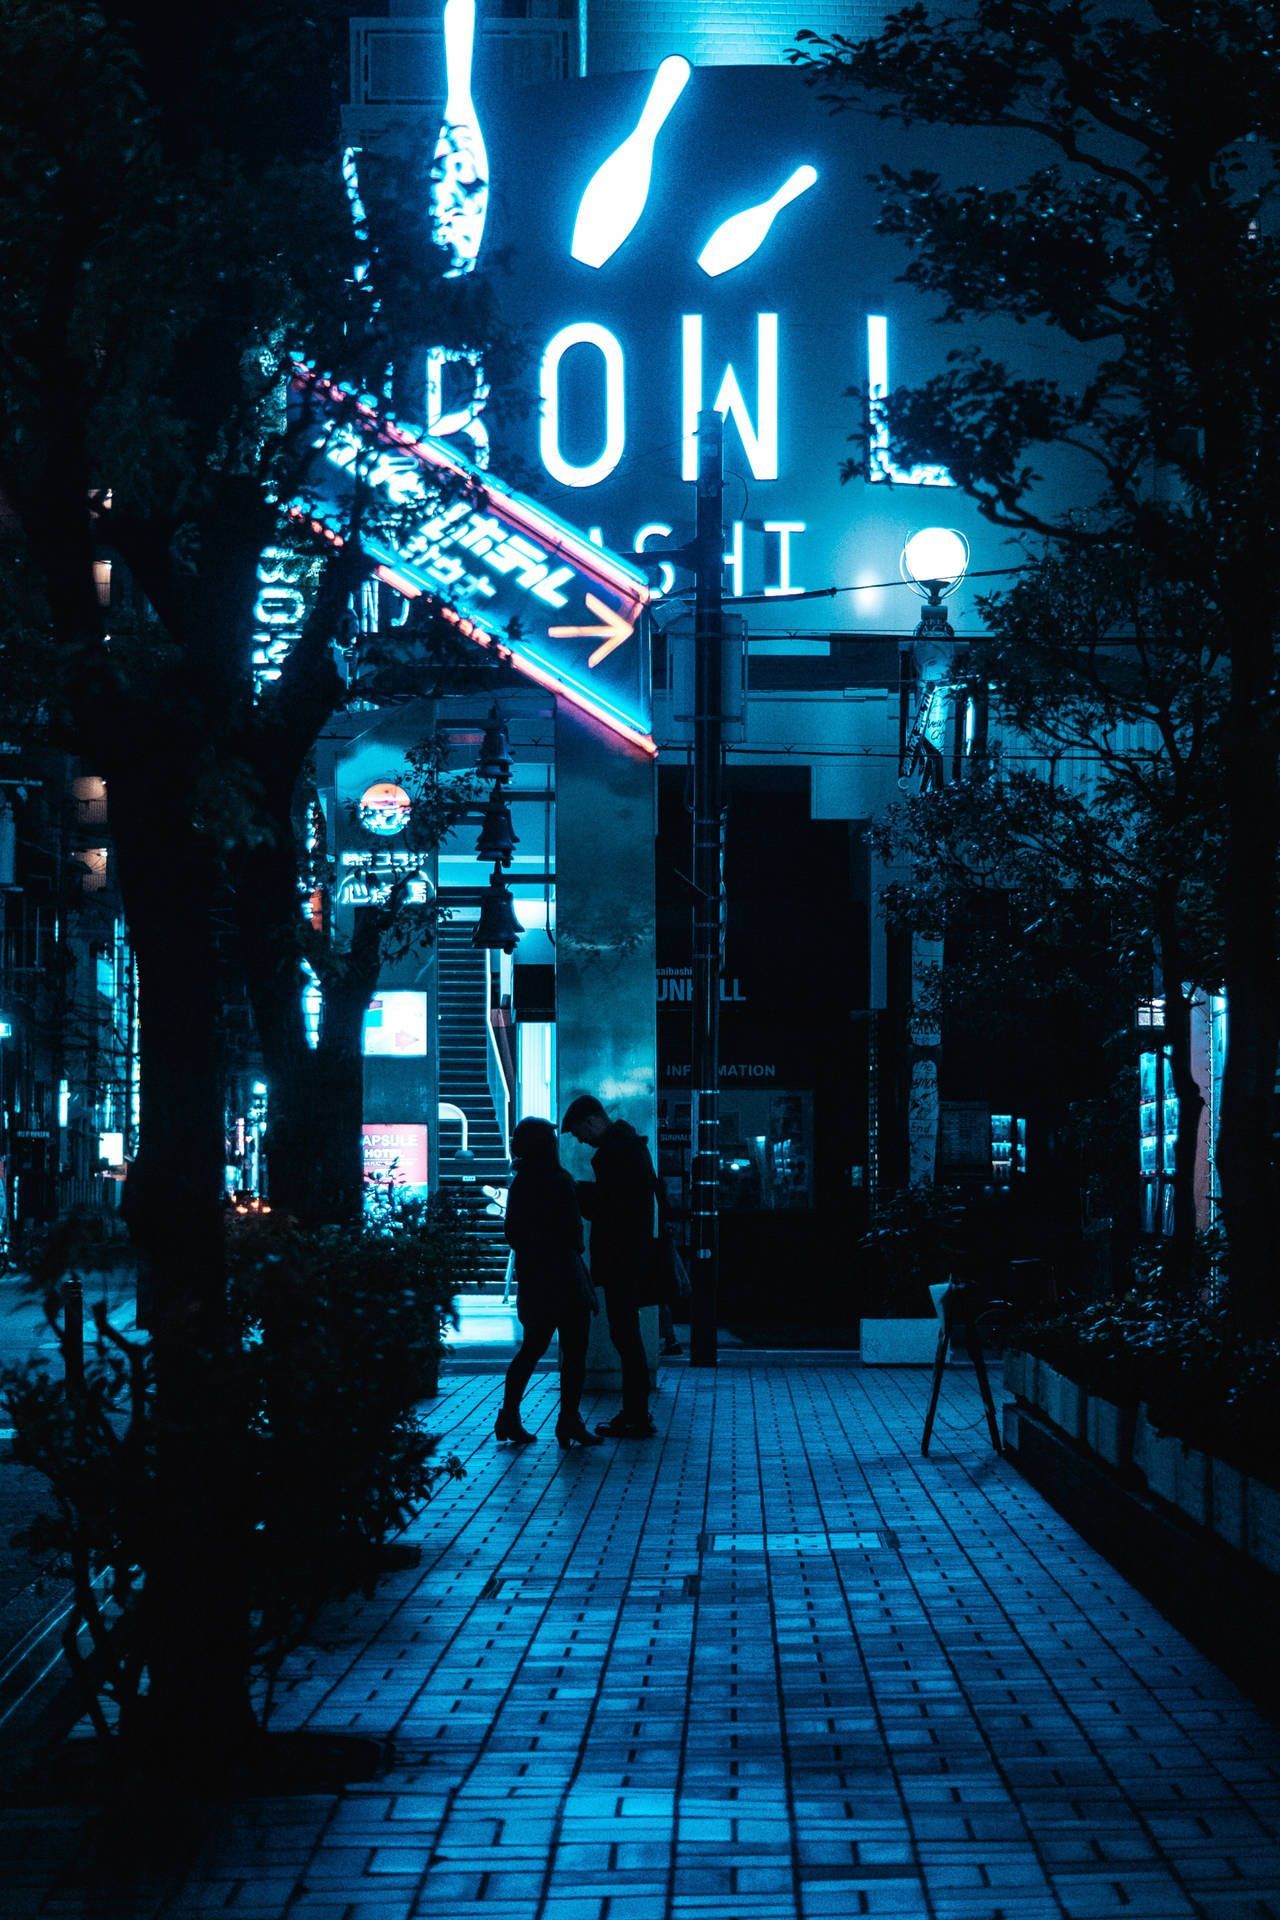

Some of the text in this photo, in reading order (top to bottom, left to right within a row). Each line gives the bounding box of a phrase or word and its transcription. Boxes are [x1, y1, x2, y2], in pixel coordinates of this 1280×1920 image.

[426, 313, 958, 488] BOWL
[666, 1064, 776, 1077] INFMATION
[361, 1134, 419, 1147] APSULE
